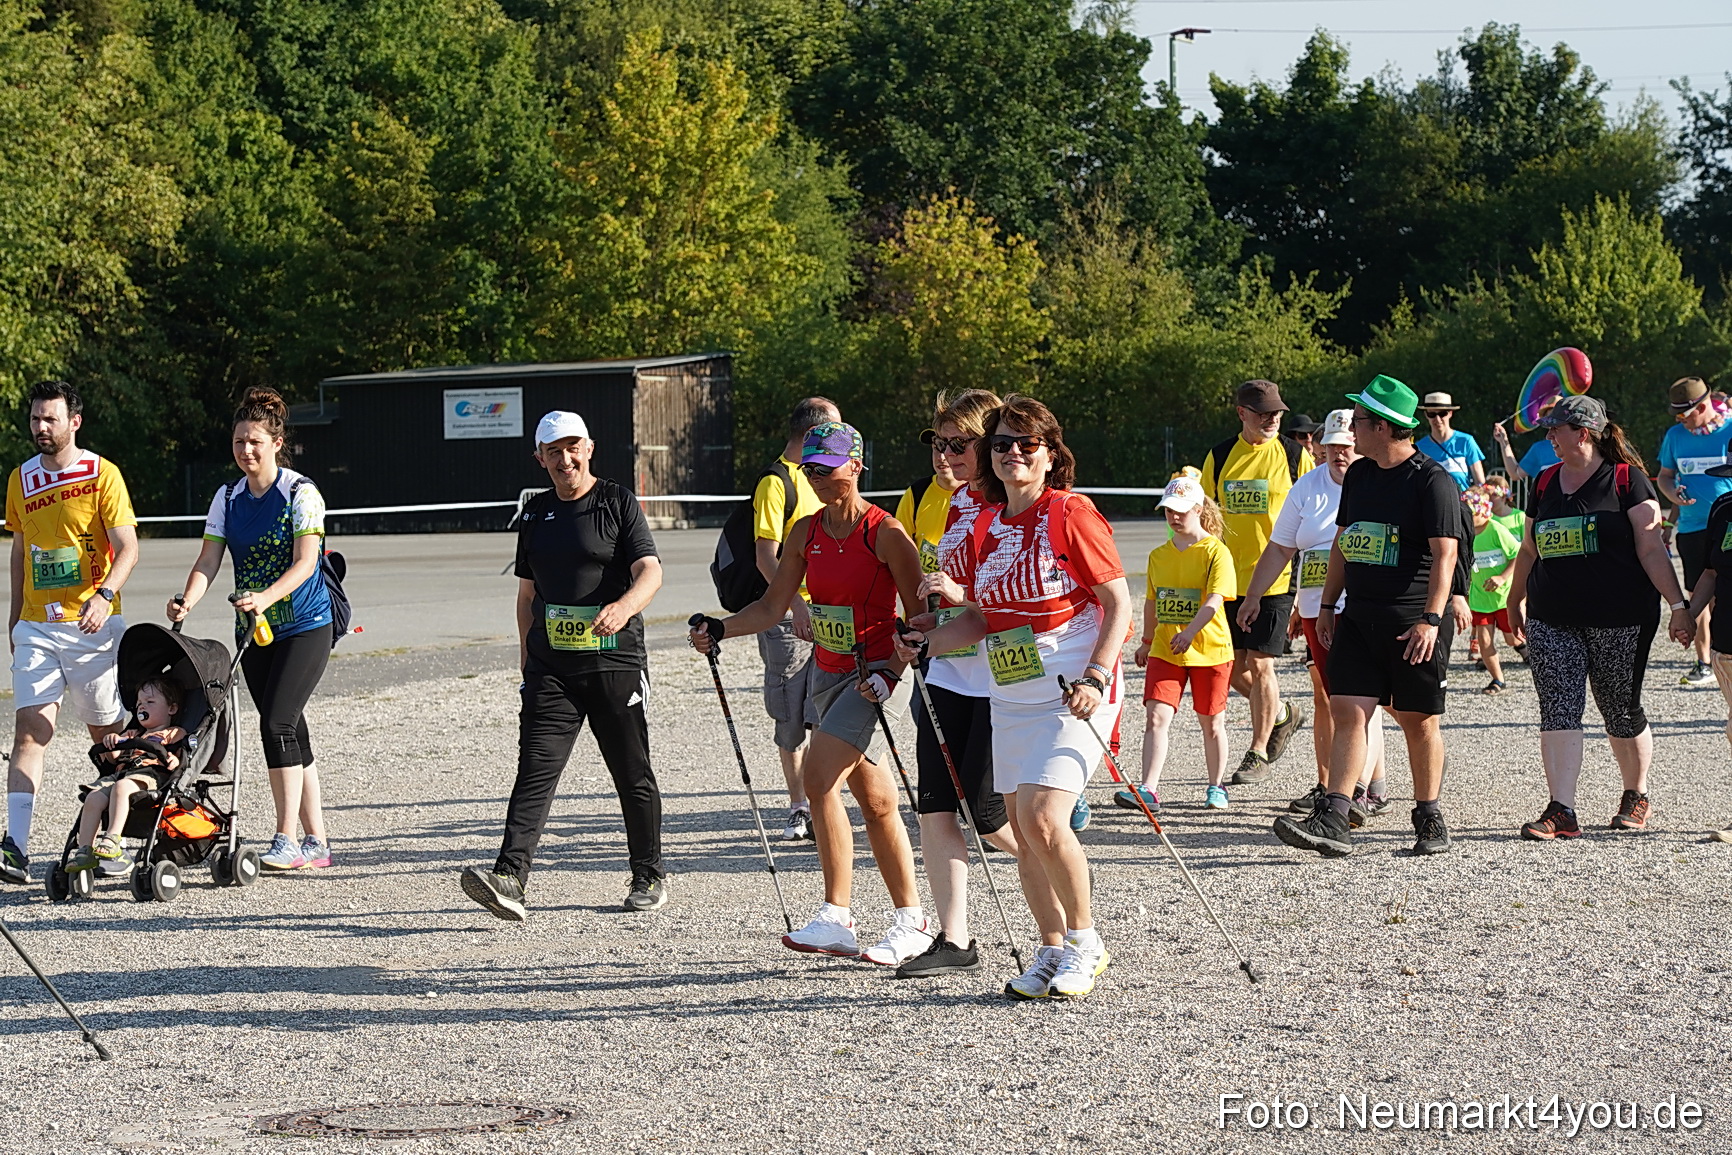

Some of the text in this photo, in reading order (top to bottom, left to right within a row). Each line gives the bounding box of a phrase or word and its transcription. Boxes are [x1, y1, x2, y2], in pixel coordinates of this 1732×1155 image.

[25, 483, 100, 514] MAX BÖGL
[1231, 491, 1261, 503] 1276
[1346, 535, 1371, 549] 302
[1545, 530, 1569, 546] 291
[41, 561, 65, 577] 811
[1307, 562, 1328, 576] 273
[1161, 600, 1193, 613] 1254
[555, 620, 586, 636] 499
[813, 619, 845, 639] 1110
[554, 635, 571, 643] Dinkel
[993, 645, 1028, 669] 1121
[1028, 646, 1040, 670] 2022
